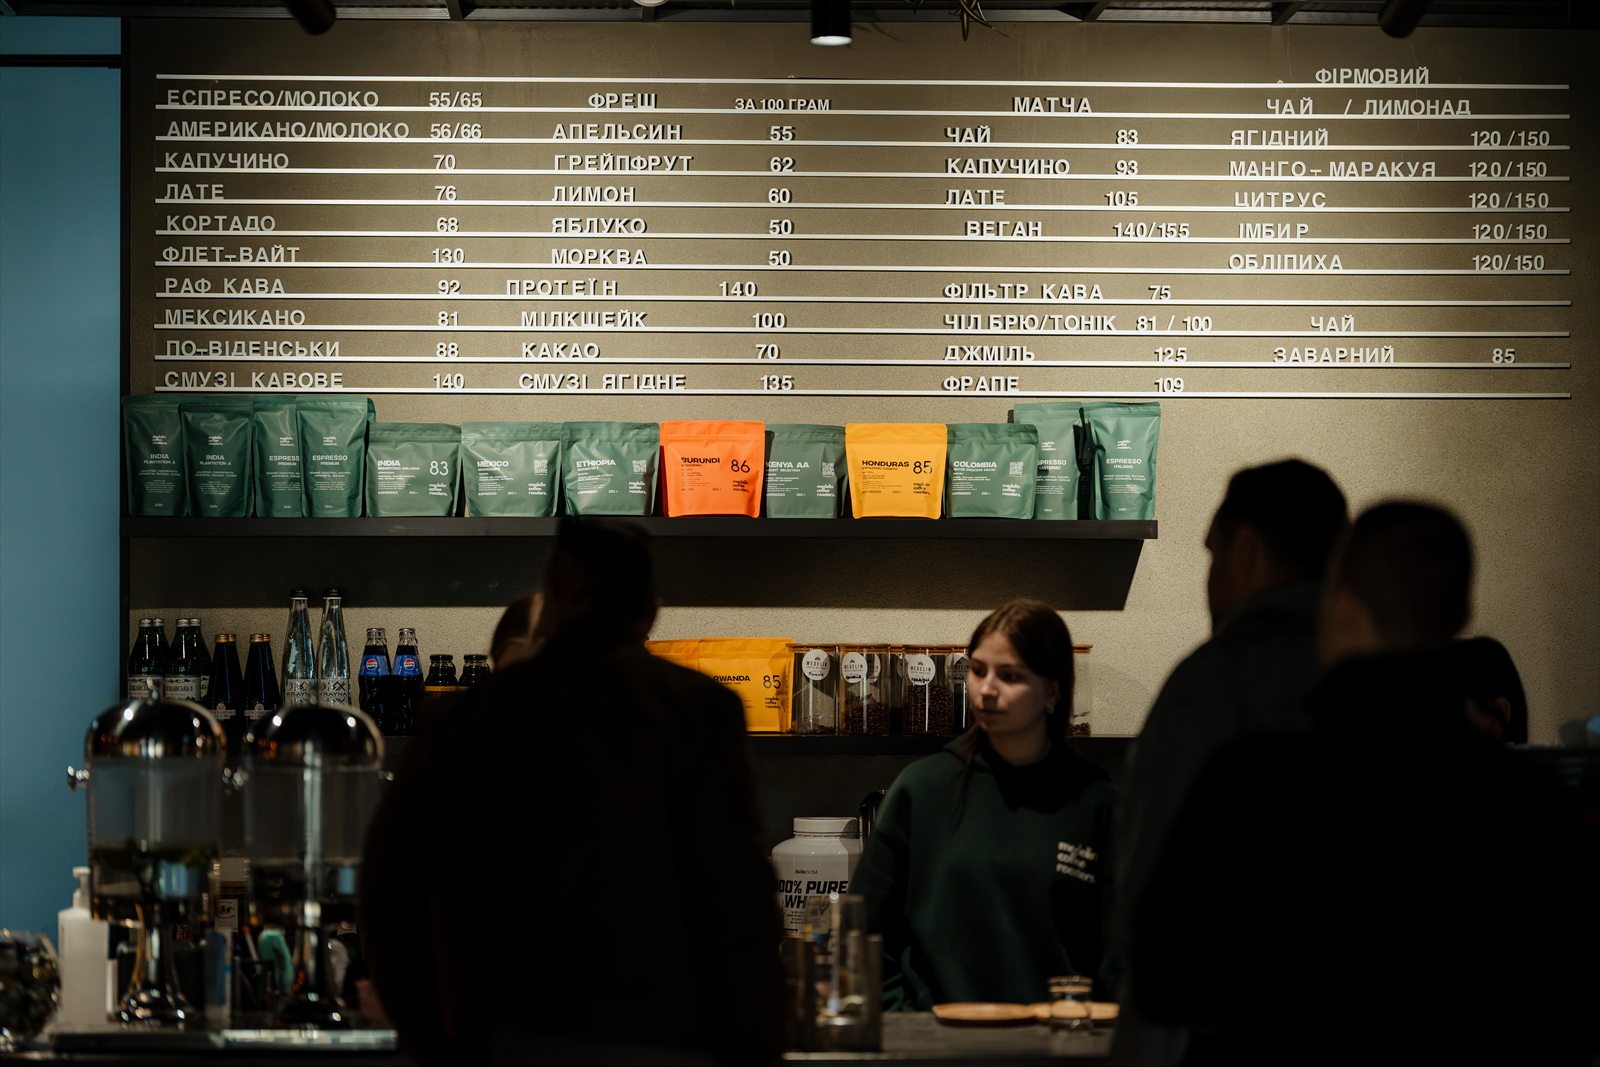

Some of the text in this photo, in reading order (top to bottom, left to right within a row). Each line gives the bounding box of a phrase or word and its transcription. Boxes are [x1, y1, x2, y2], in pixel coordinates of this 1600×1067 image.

[1315, 67, 1429, 84] ФІРМОВИЙ
[168, 90, 379, 107] ЕСПРЕСО/МОЛОКО
[429, 92, 482, 108] 55/65
[588, 92, 657, 109] ФРЕШ
[735, 99, 829, 111] ЗА 100 ГРАМ
[1013, 97, 1092, 113] МАТЧА
[1267, 97, 1313, 115] ЧАЙ
[1363, 100, 1471, 116] ЛИМОНАД
[167, 122, 409, 139] АМЕРИКАНО/МОЛОКО
[430, 123, 482, 139] 56/66
[553, 124, 682, 140] АПЕЛЬСИН
[770, 126, 793, 141] 55
[946, 126, 991, 143] ЧАЙ
[1117, 130, 1138, 145] 83
[1231, 128, 1329, 146] ЯГІДНИЙ
[165, 152, 289, 169] КАПУЧИНО
[433, 154, 456, 170] 70
[554, 153, 693, 171] ГРЕЙПФРУТ
[770, 157, 794, 172] 62
[946, 158, 1070, 175] КАПУЧИНО
[1116, 161, 1138, 176] 93
[164, 184, 224, 200] ЛАТЕ
[434, 186, 457, 201] 76
[552, 186, 635, 202] ЛИМОН
[768, 188, 791, 204] 60
[945, 189, 1005, 205] ЛАТЕ
[1106, 192, 1138, 207] 105
[1234, 192, 1326, 208] ЦИТРУС
[166, 215, 276, 232] КОРТАДО
[436, 218, 459, 232] 68
[552, 218, 646, 234] ЯБЛУКО
[769, 219, 792, 235] 50
[966, 221, 1042, 237] ВЕГАН
[1114, 222, 1189, 238] 140/155
[1239, 223, 1308, 239] ІМБИР
[162, 244, 300, 262] ФЛЕТ-ВАЙТ
[432, 248, 465, 264] 130
[552, 249, 647, 265] МОРКВА
[768, 251, 791, 266] 50
[1229, 254, 1343, 271] ОБЛІПИХА
[165, 278, 285, 294] РАФ КАВА
[438, 280, 460, 295] 92
[507, 278, 618, 296] ПРОТЕЇН
[719, 281, 757, 297] 140
[944, 283, 1103, 300] ФІЛЬТР КАВА
[1149, 286, 1171, 301] 75
[165, 309, 305, 326] МЕКСИКАНО
[438, 311, 459, 326] 81
[521, 309, 647, 327] МІЛКШЕЙК
[752, 312, 786, 328] 100
[945, 314, 1116, 331] ЧІЛ БРЮ/ТОНІК
[1136, 316, 1157, 331] 81
[1183, 316, 1212, 332] 100
[1311, 315, 1354, 332] ЧАЙ
[166, 341, 340, 357] ПО-ВІДЕНСЬКИ
[436, 342, 459, 358] 88
[522, 343, 599, 358] КАКАО
[756, 344, 779, 359] 70
[945, 346, 1035, 361] ДЖМІЛЬ
[1154, 347, 1187, 363] 125
[1274, 346, 1394, 364] ЗАВАРНИЙ
[1492, 349, 1515, 363] 85
[165, 371, 343, 388] СМУЗІ КАВОВЕ
[433, 373, 465, 389] 140
[519, 374, 686, 390] СМУЗІ ЯГІДНЕ
[761, 375, 793, 391] 135
[943, 376, 1019, 392] ФРАПЕ
[1154, 378, 1184, 393] 109
[430, 460, 448, 476] 83
[731, 459, 750, 473] 86
[913, 461, 932, 474] 85
[763, 675, 781, 689] 85
[806, 881, 848, 894] PURE
